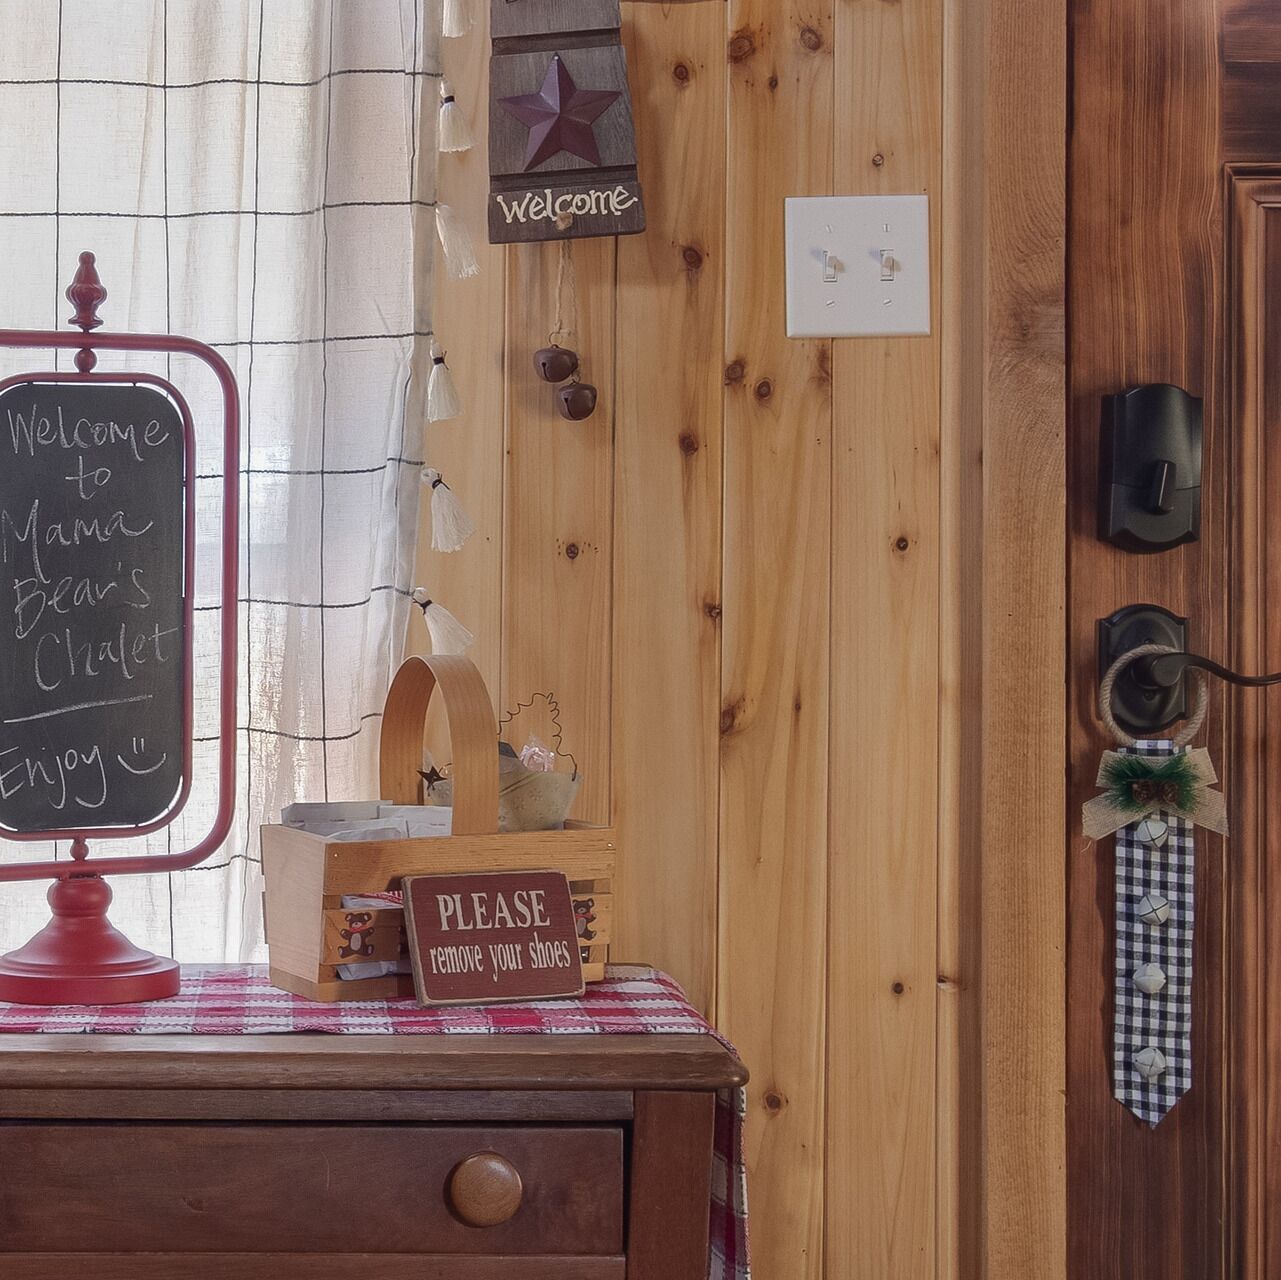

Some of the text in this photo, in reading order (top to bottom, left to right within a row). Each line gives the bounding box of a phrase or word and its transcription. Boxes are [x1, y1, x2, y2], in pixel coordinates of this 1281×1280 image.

[7, 403, 169, 461] Welcome
[64, 455, 112, 500] to
[1, 498, 153, 584] Mama
[35, 622, 179, 691] Chalet
[436, 890, 551, 931] PLEASE
[430, 931, 571, 982] remove your shoes
